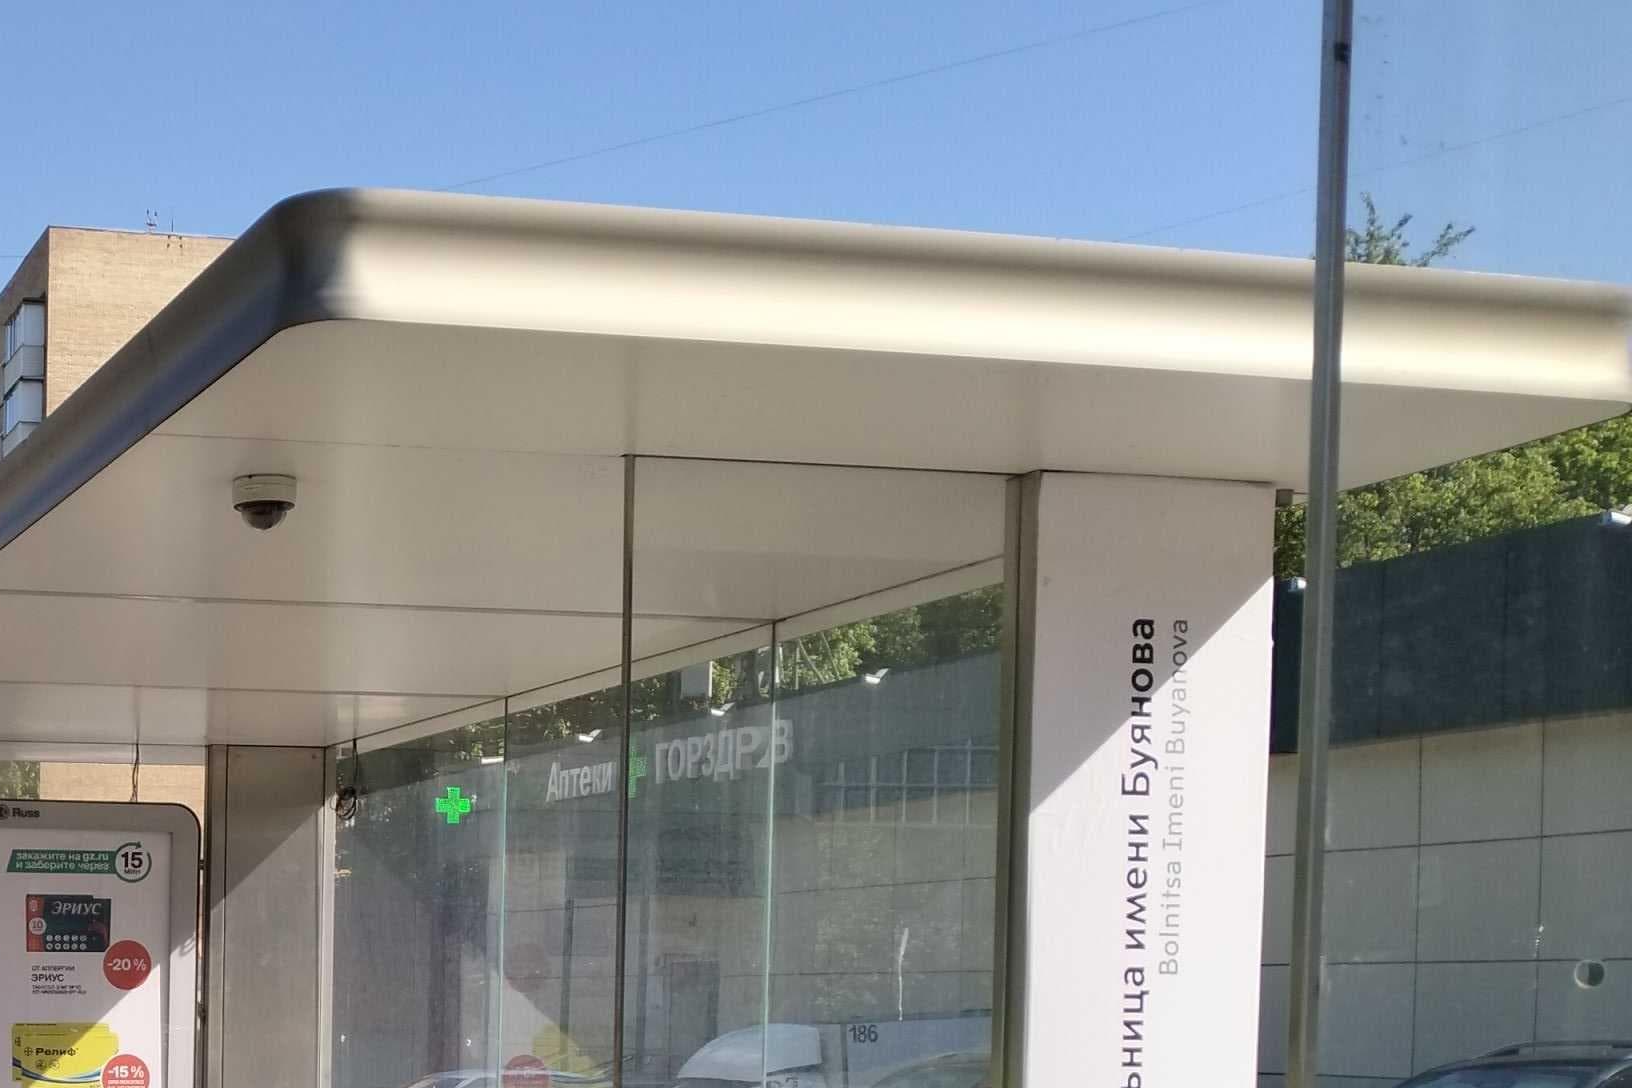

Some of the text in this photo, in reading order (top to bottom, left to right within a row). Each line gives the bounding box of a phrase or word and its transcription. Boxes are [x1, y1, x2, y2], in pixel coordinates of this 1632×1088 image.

[1122, 618, 1158, 797] Буянова
[546, 761, 615, 801] Аптеки
[1159, 619, 1191, 976] Bolnitsa Imeni Buyanova
[12, 807, 40, 818] Russ
[16, 851, 66, 860] закажите
[82, 852, 109, 862] gz.ru
[120, 850, 144, 869] 15
[1124, 814, 1149, 951] имени
[52, 901, 102, 915] ЭРИУС
[31, 973, 65, 982] ЭРИУС
[849, 1023, 879, 1043] 186
